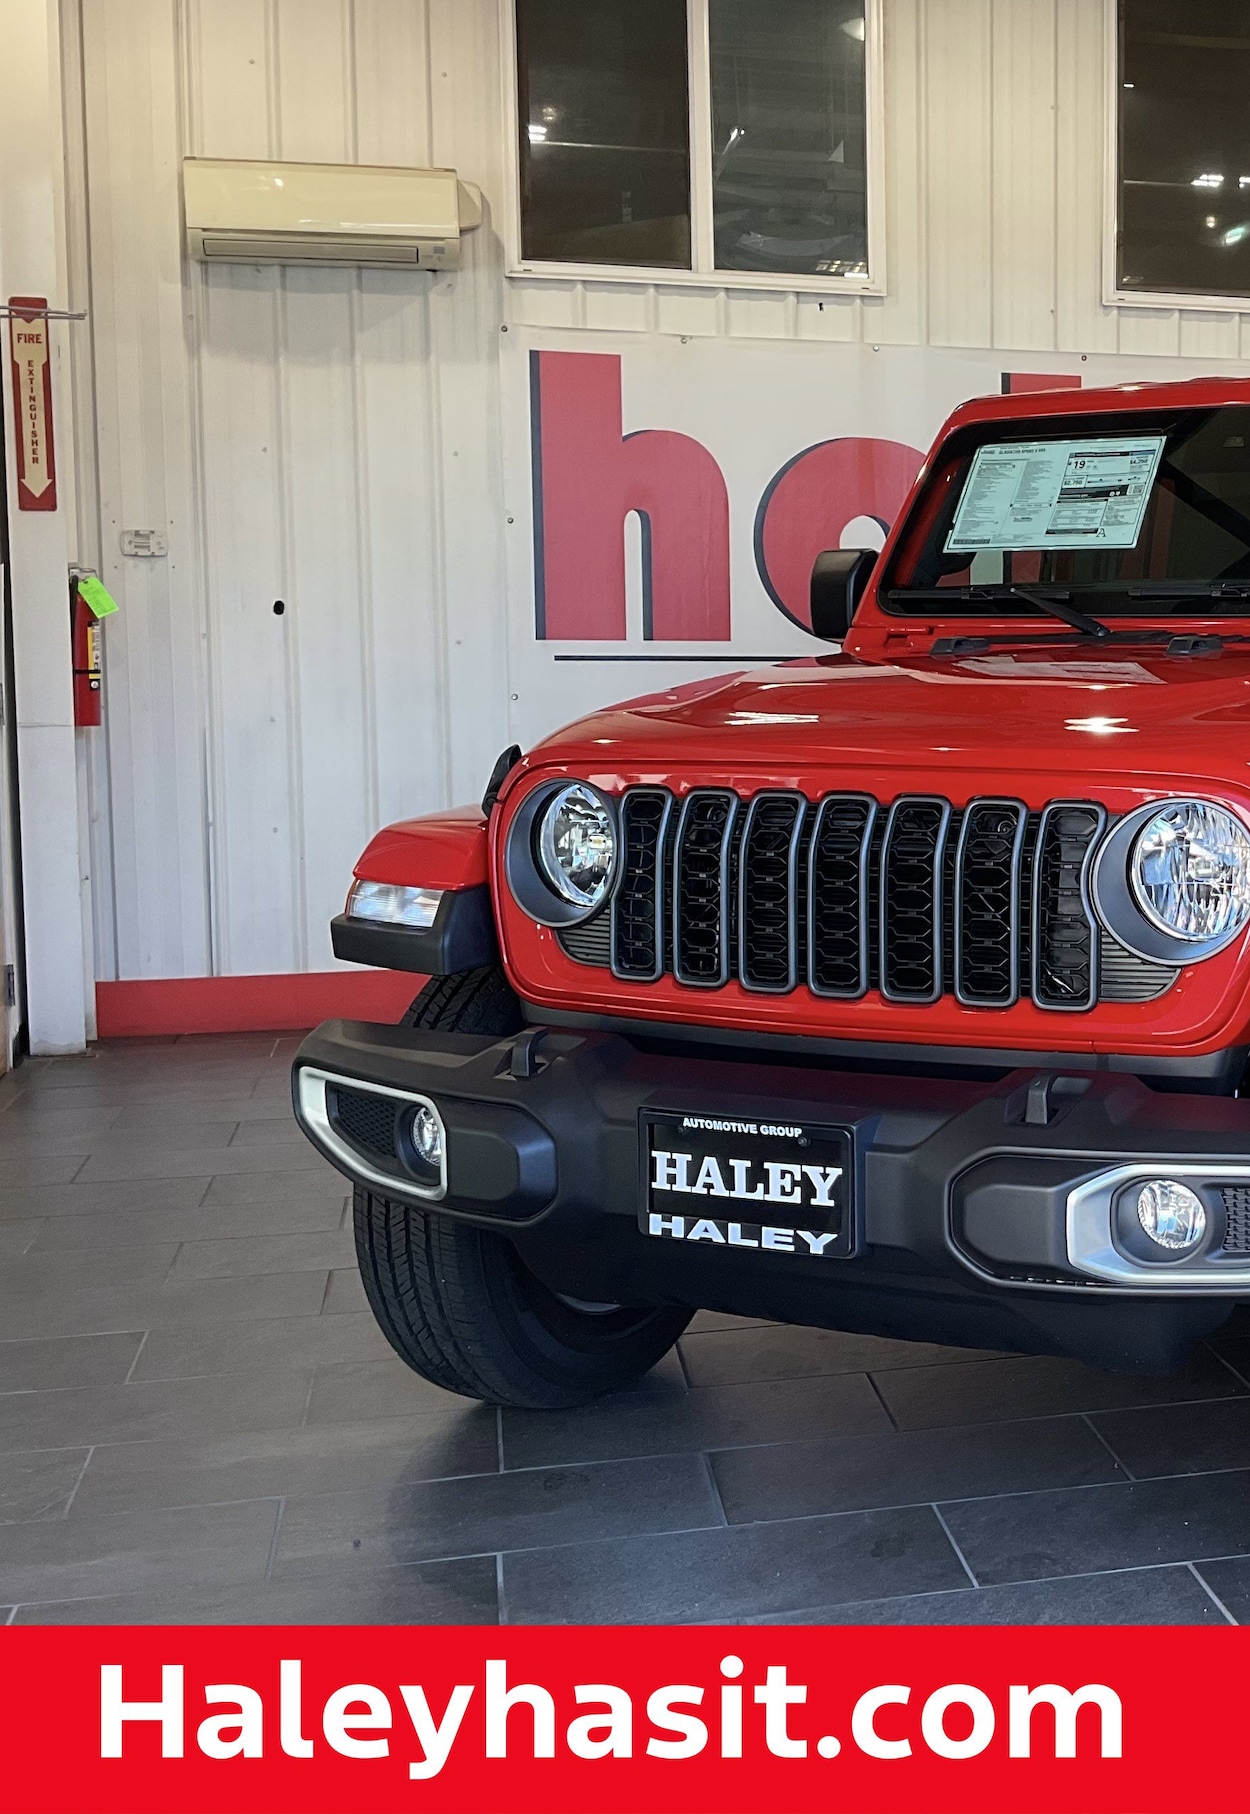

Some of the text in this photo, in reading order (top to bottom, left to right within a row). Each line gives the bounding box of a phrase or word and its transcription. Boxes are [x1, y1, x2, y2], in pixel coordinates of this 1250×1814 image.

[17, 333, 42, 344] FIRE
[28, 360, 38, 464] EXTINGUISHER
[1073, 460, 1085, 469] 19
[683, 1118, 802, 1137] AUTOMOTIVE GROUP
[651, 1150, 842, 1207] HALEY
[649, 1213, 838, 1255] HALEY
